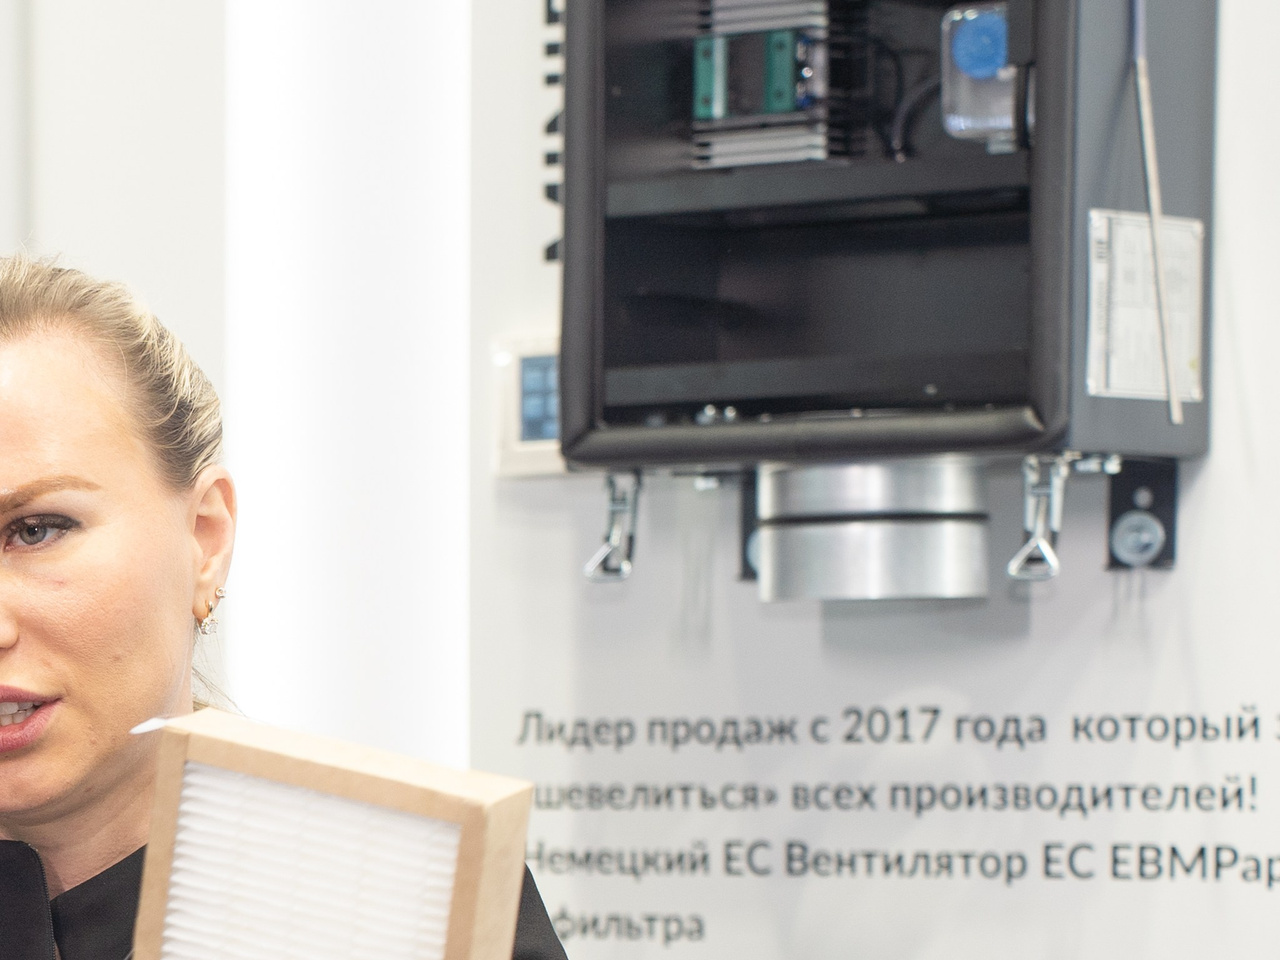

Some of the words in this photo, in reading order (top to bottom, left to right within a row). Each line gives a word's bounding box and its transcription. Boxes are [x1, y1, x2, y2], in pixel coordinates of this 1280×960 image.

[518, 710, 636, 751] Лидер
[647, 717, 797, 750] продаж
[809, 716, 828, 744] с
[843, 706, 941, 743] 2017
[955, 715, 1047, 749] года
[1073, 704, 1260, 749] который
[534, 783, 778, 810] шевелиться»
[792, 783, 876, 811] всех
[890, 776, 1256, 817] производителей!
[525, 840, 710, 878] Немецкий
[723, 840, 771, 876] EC
[785, 840, 1028, 885] Вентилятор
[1043, 843, 1093, 879] EC
[552, 907, 705, 946] фильтра
